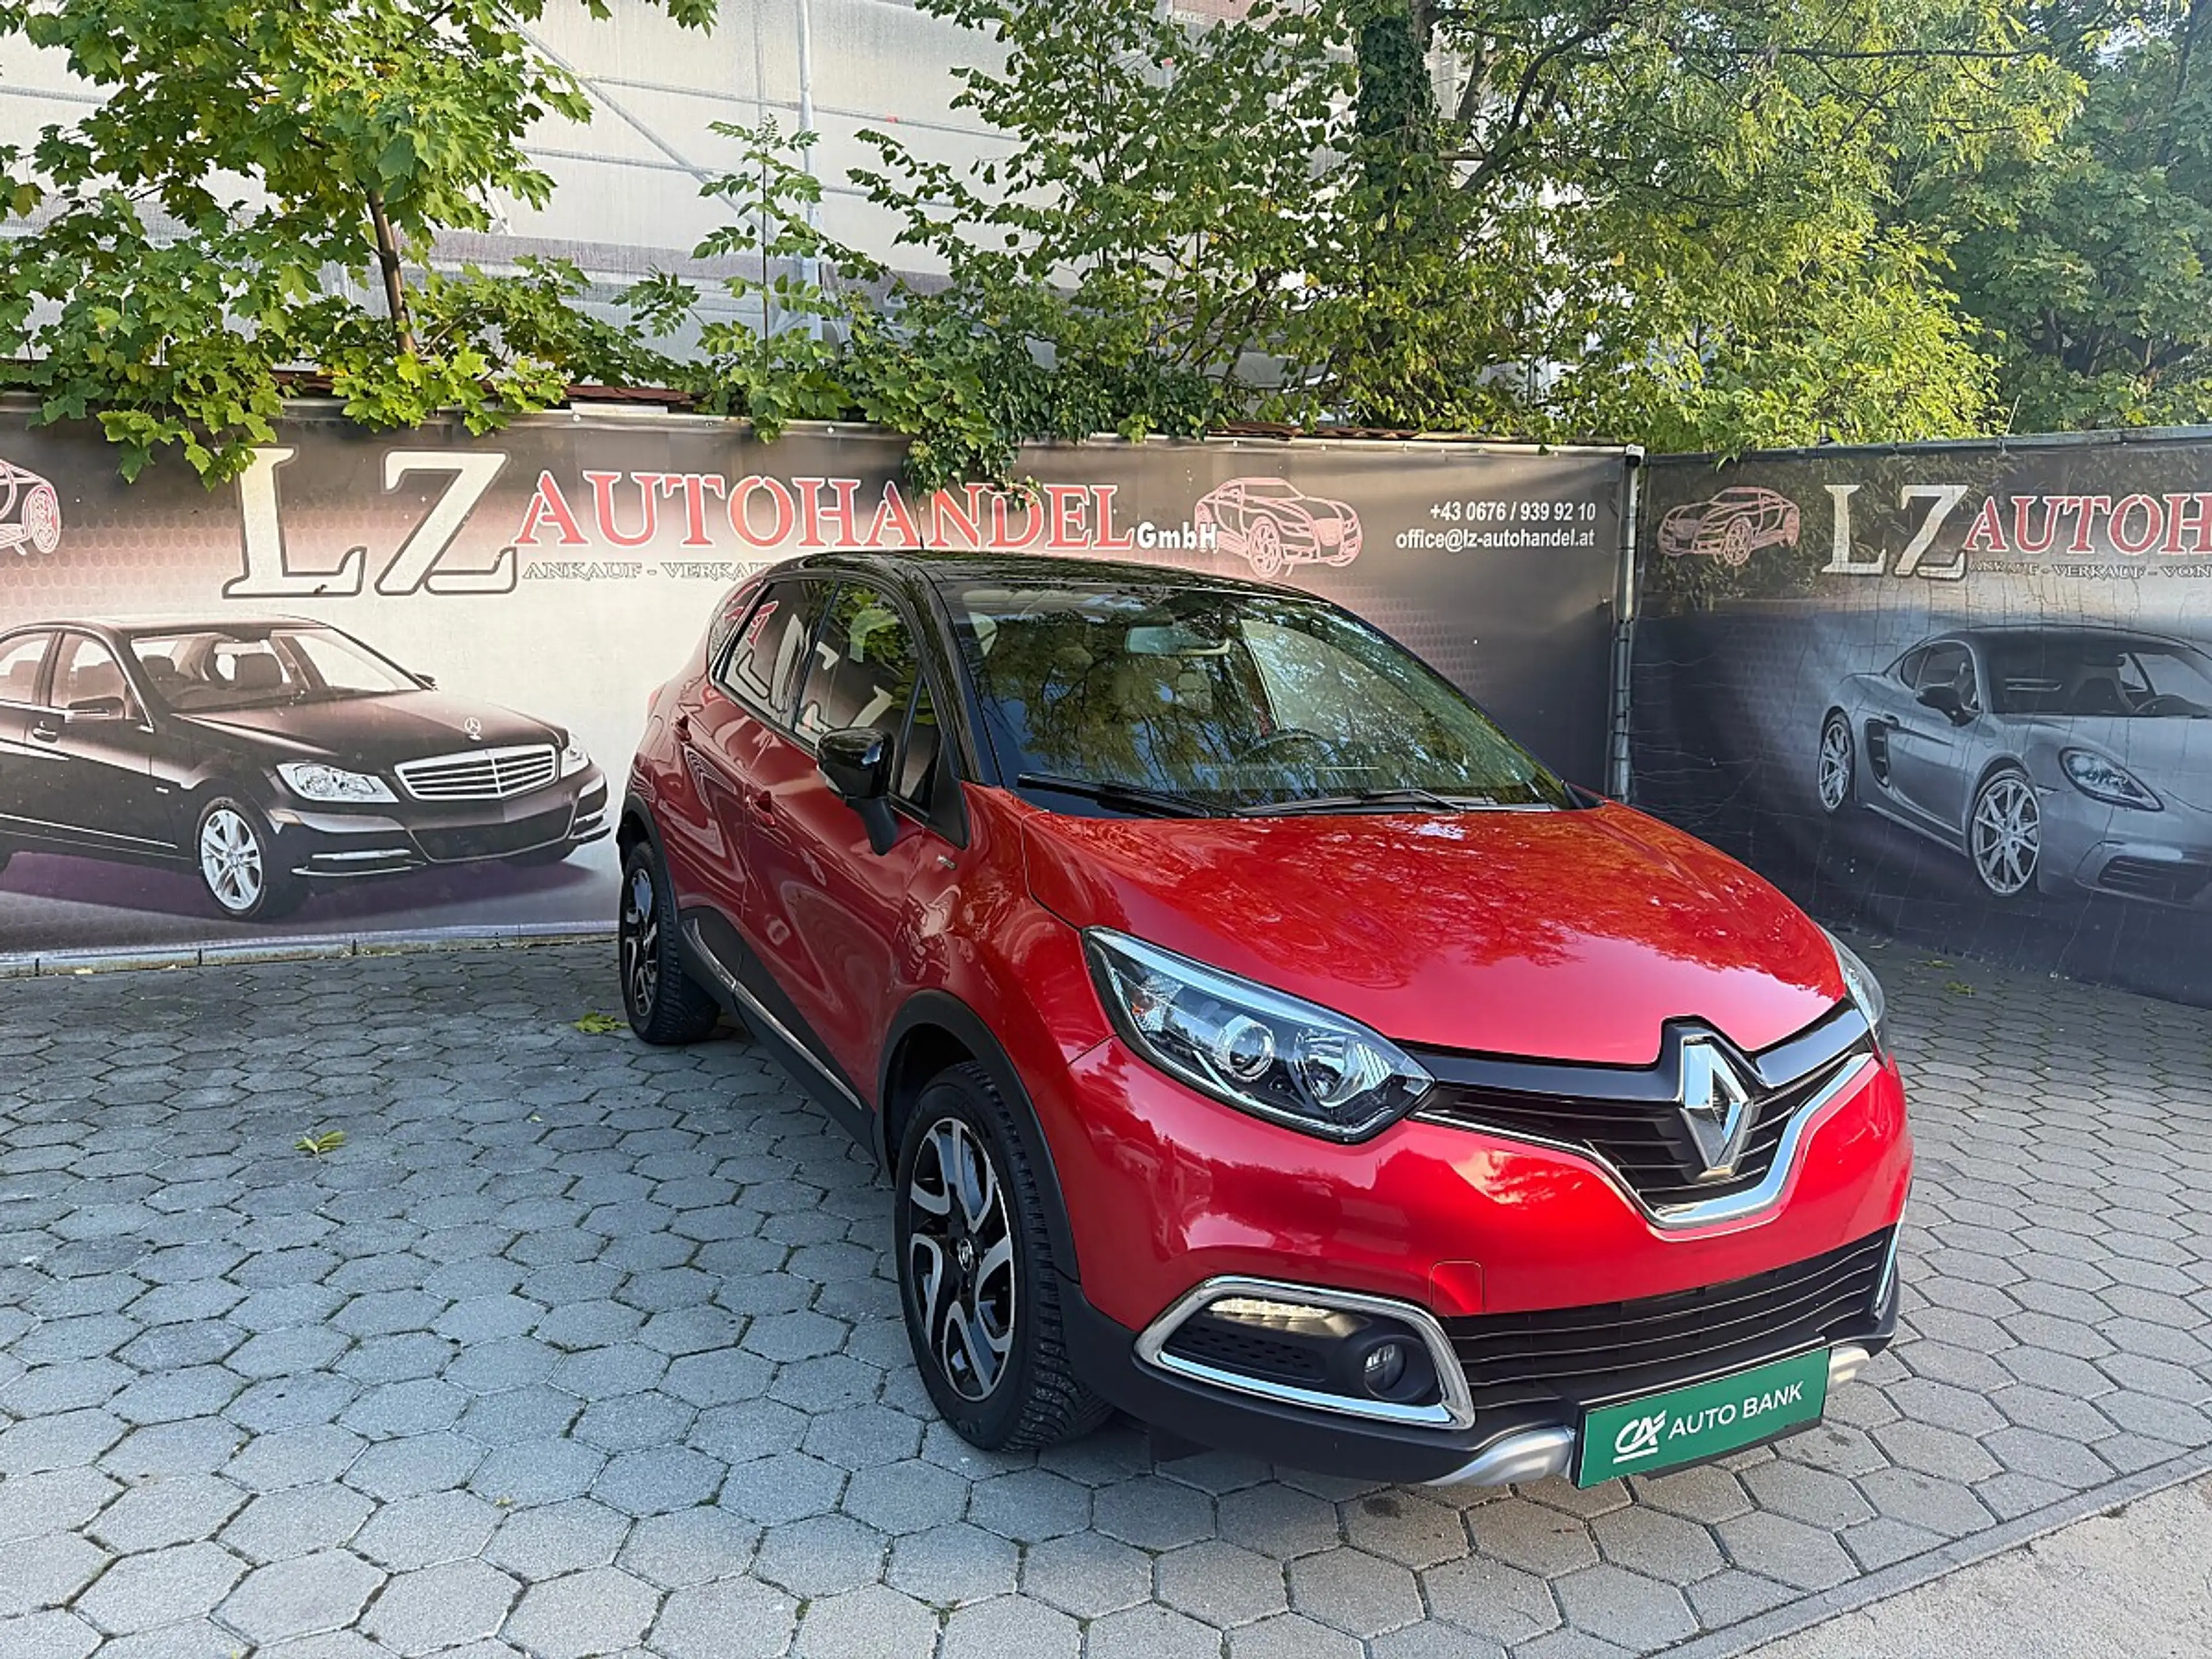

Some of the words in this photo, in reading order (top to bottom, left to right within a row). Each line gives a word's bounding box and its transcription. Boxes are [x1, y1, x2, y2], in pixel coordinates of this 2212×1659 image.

[221, 448, 518, 598] LZ
[512, 469, 1135, 551] AUTOHANDEL
[1137, 521, 1217, 549] GmbH
[1430, 502, 1461, 521] +43
[1466, 502, 1507, 521] 0676
[1509, 502, 1517, 521] /
[1520, 502, 1550, 521] 939
[1554, 503, 1574, 521] 92
[1578, 503, 1596, 521] 10
[1395, 529, 1595, 552] office@lz-autohandel.at
[1821, 484, 1969, 579] LZ
[522, 562, 642, 581] ANKAUF
[2051, 563, 2147, 581] VERKAUF
[1668, 1404, 1736, 1440] AUTO
[1742, 1381, 1804, 1418] BANK
